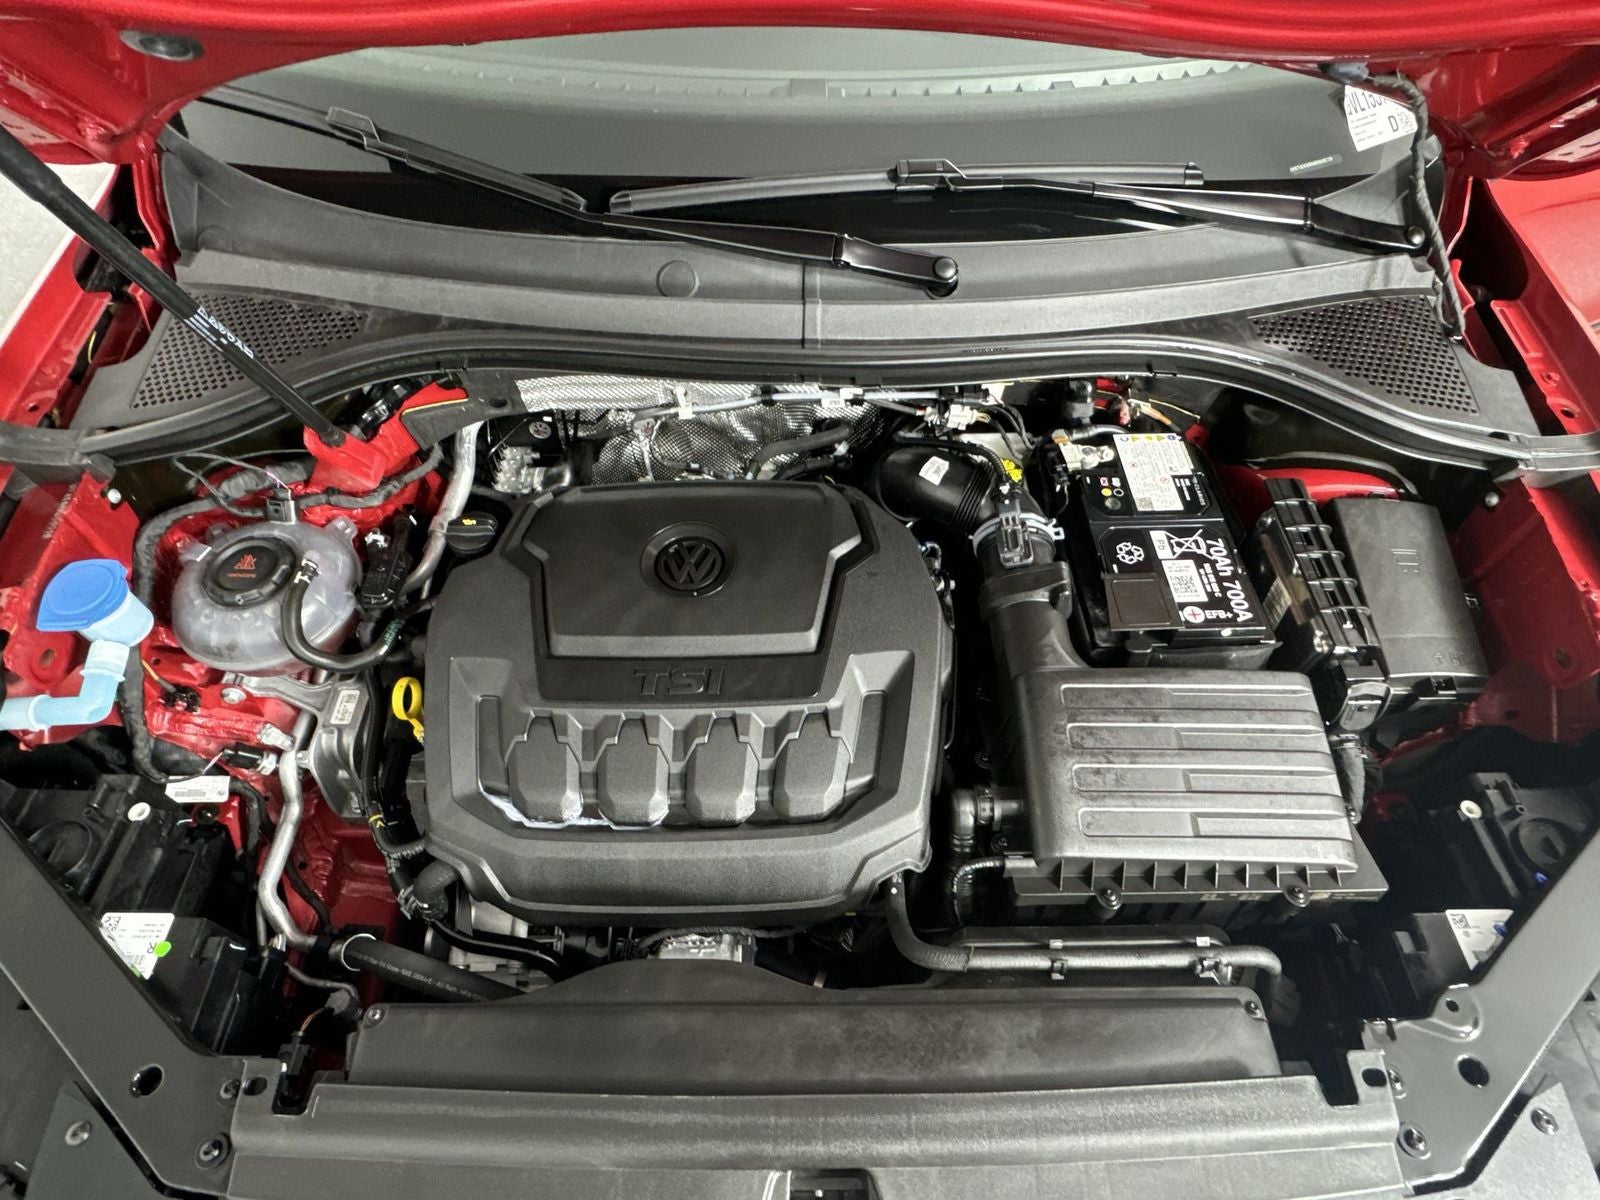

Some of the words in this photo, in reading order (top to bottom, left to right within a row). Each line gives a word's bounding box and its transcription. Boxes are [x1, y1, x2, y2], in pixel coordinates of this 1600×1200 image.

[1387, 115, 1399, 133] D
[1205, 538, 1234, 577] 70Ah
[1223, 580, 1254, 623] 700A
[634, 667, 725, 696] TSI
